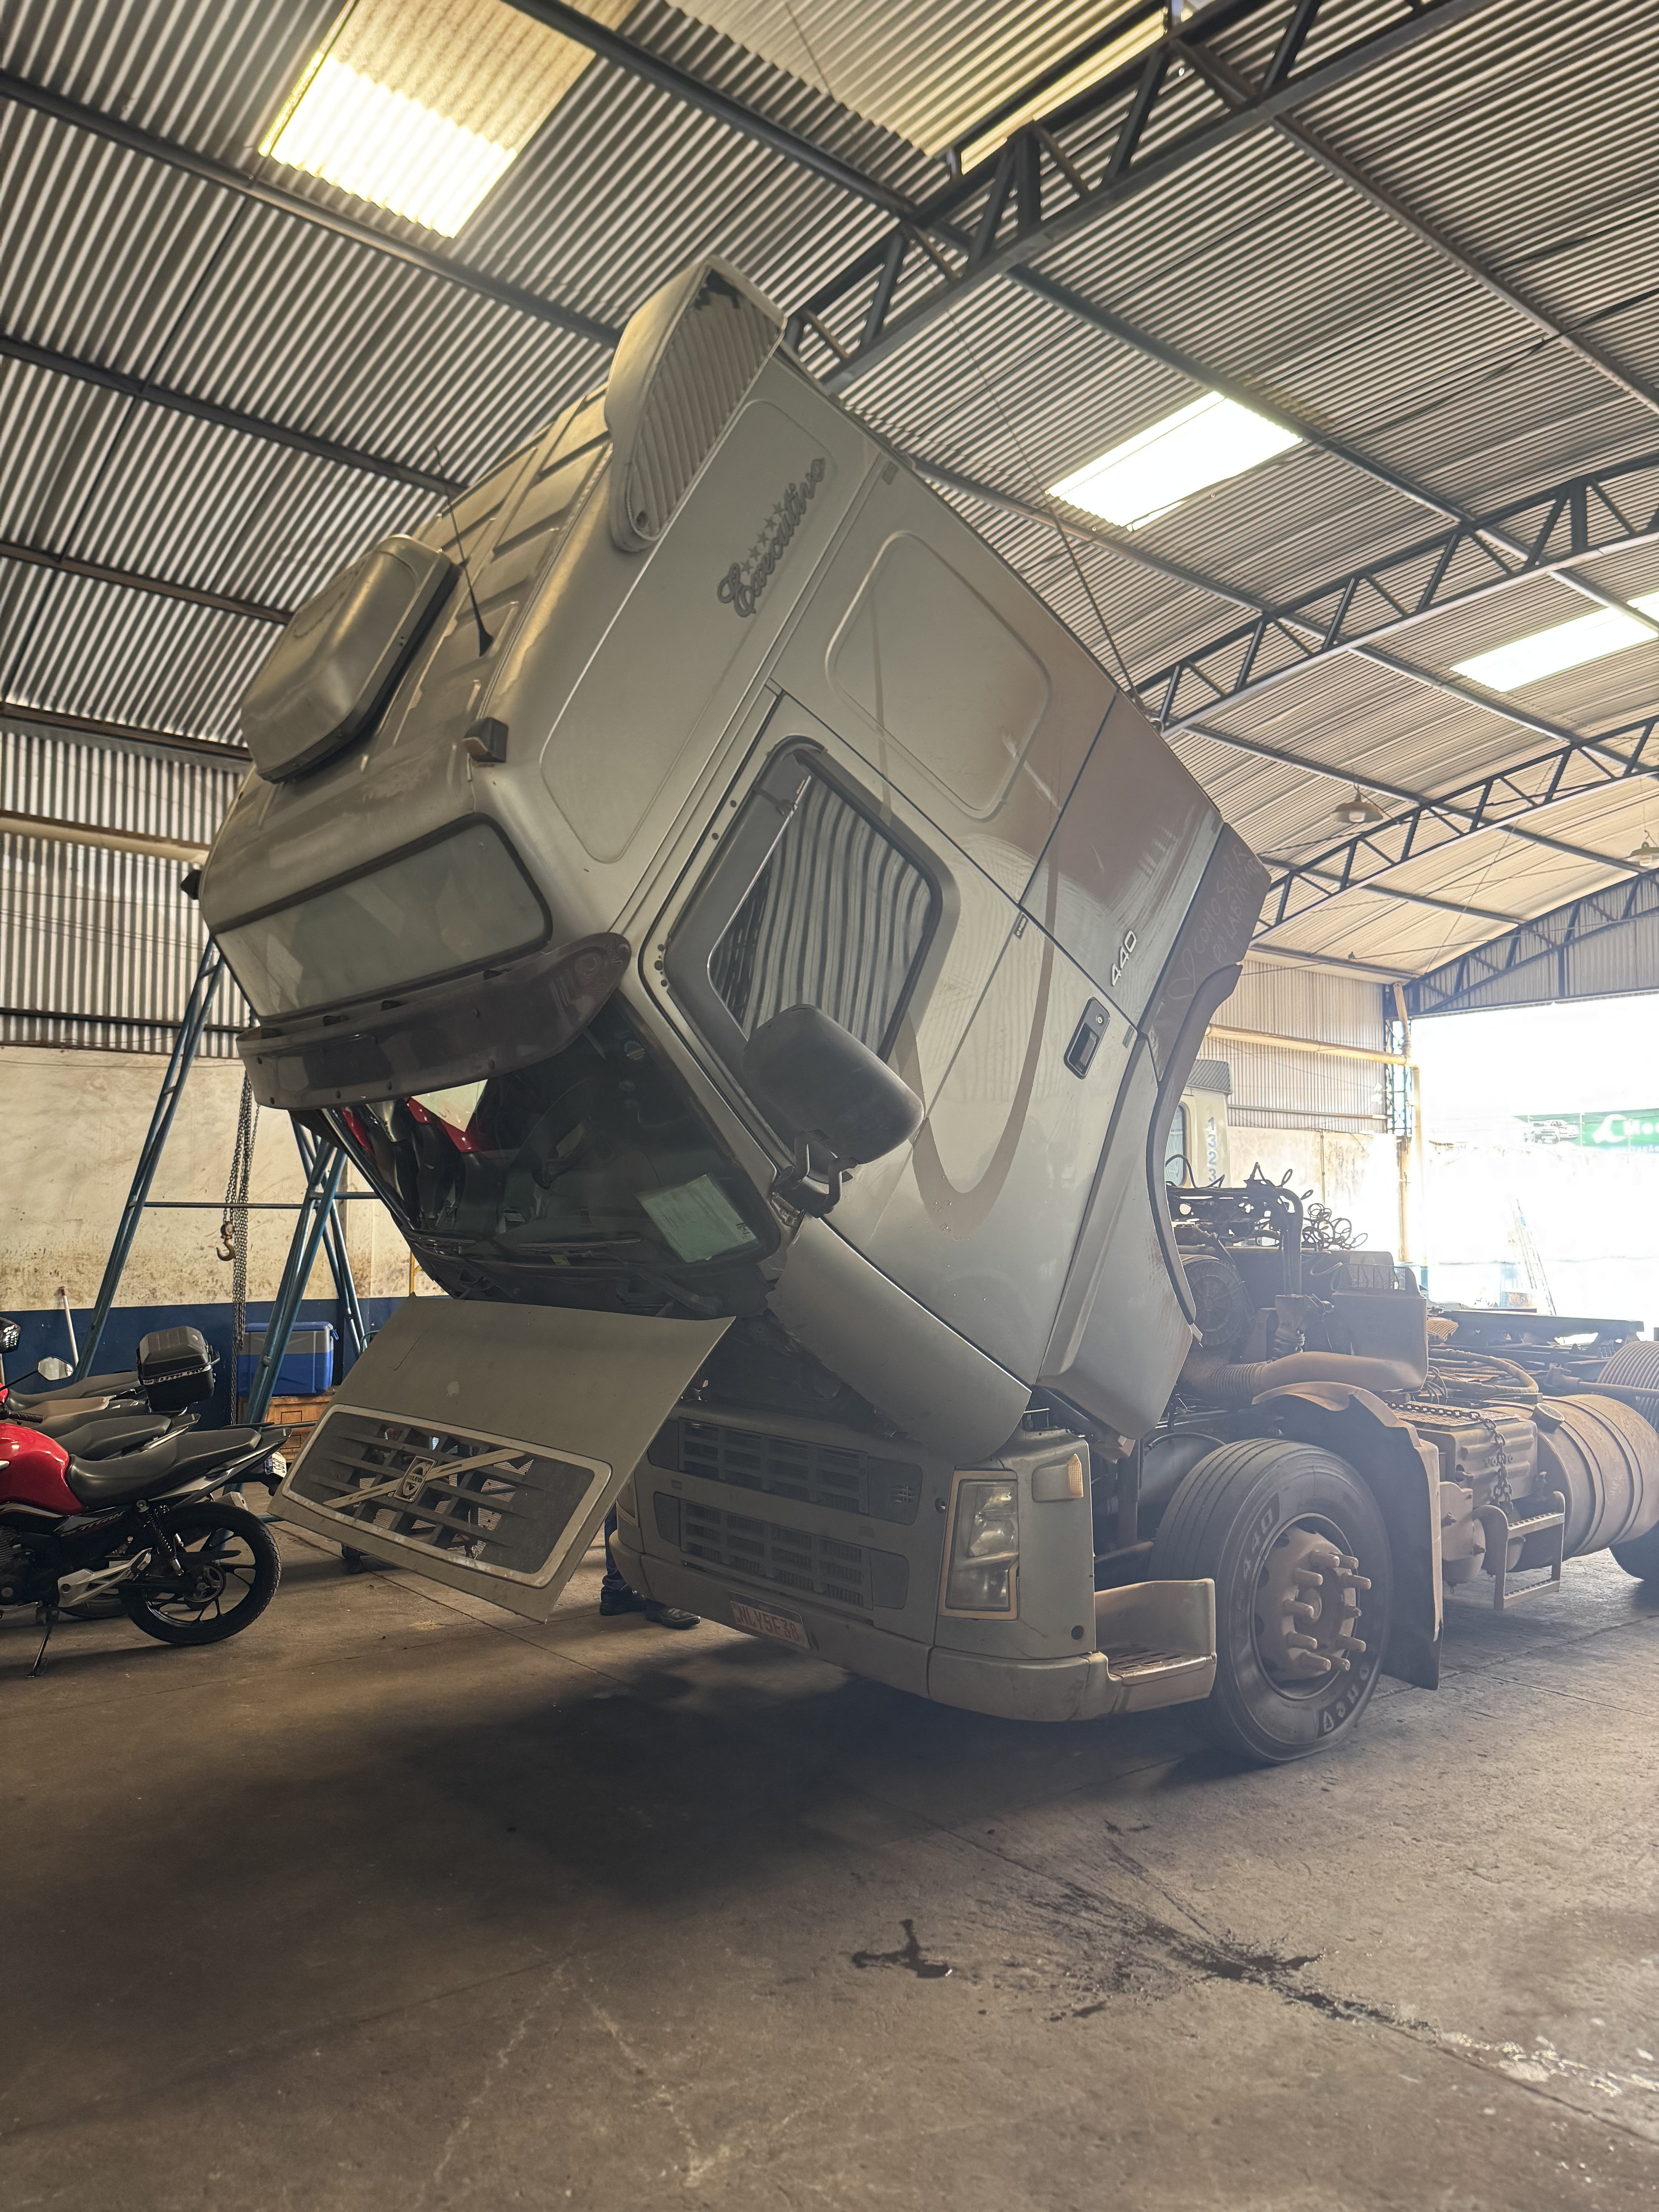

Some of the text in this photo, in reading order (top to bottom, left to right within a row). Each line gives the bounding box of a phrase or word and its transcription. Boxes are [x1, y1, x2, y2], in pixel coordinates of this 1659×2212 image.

[717, 457, 825, 618] Executive
[1111, 930, 1137, 986] 440
[1207, 1116, 1217, 1182] 1323
[1483, 1454, 1514, 1467] VOO
[80, 1510, 127, 1531] TITAN
